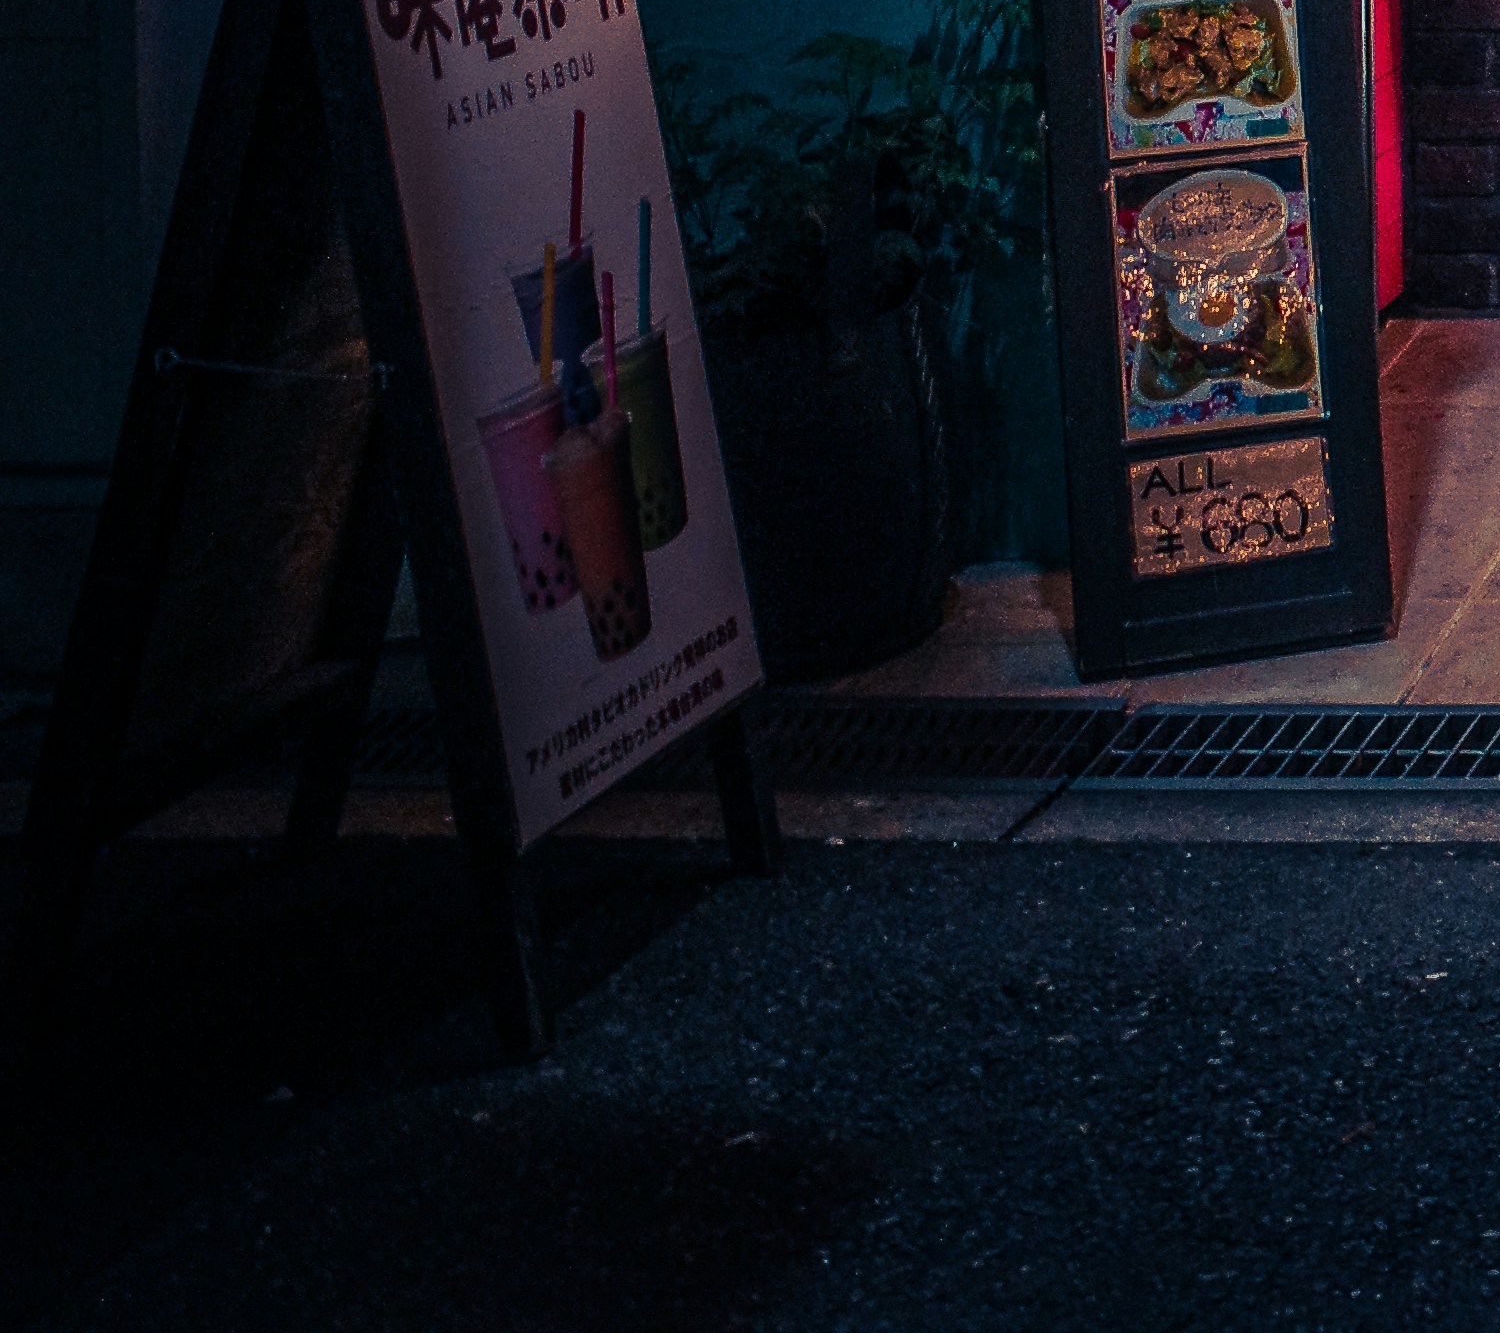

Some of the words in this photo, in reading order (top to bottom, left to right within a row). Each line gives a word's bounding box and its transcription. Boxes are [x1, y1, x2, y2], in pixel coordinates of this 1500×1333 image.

[447, 82, 514, 130] ASIAN
[524, 51, 596, 100] SABOU
[1141, 457, 1232, 499] ALL
